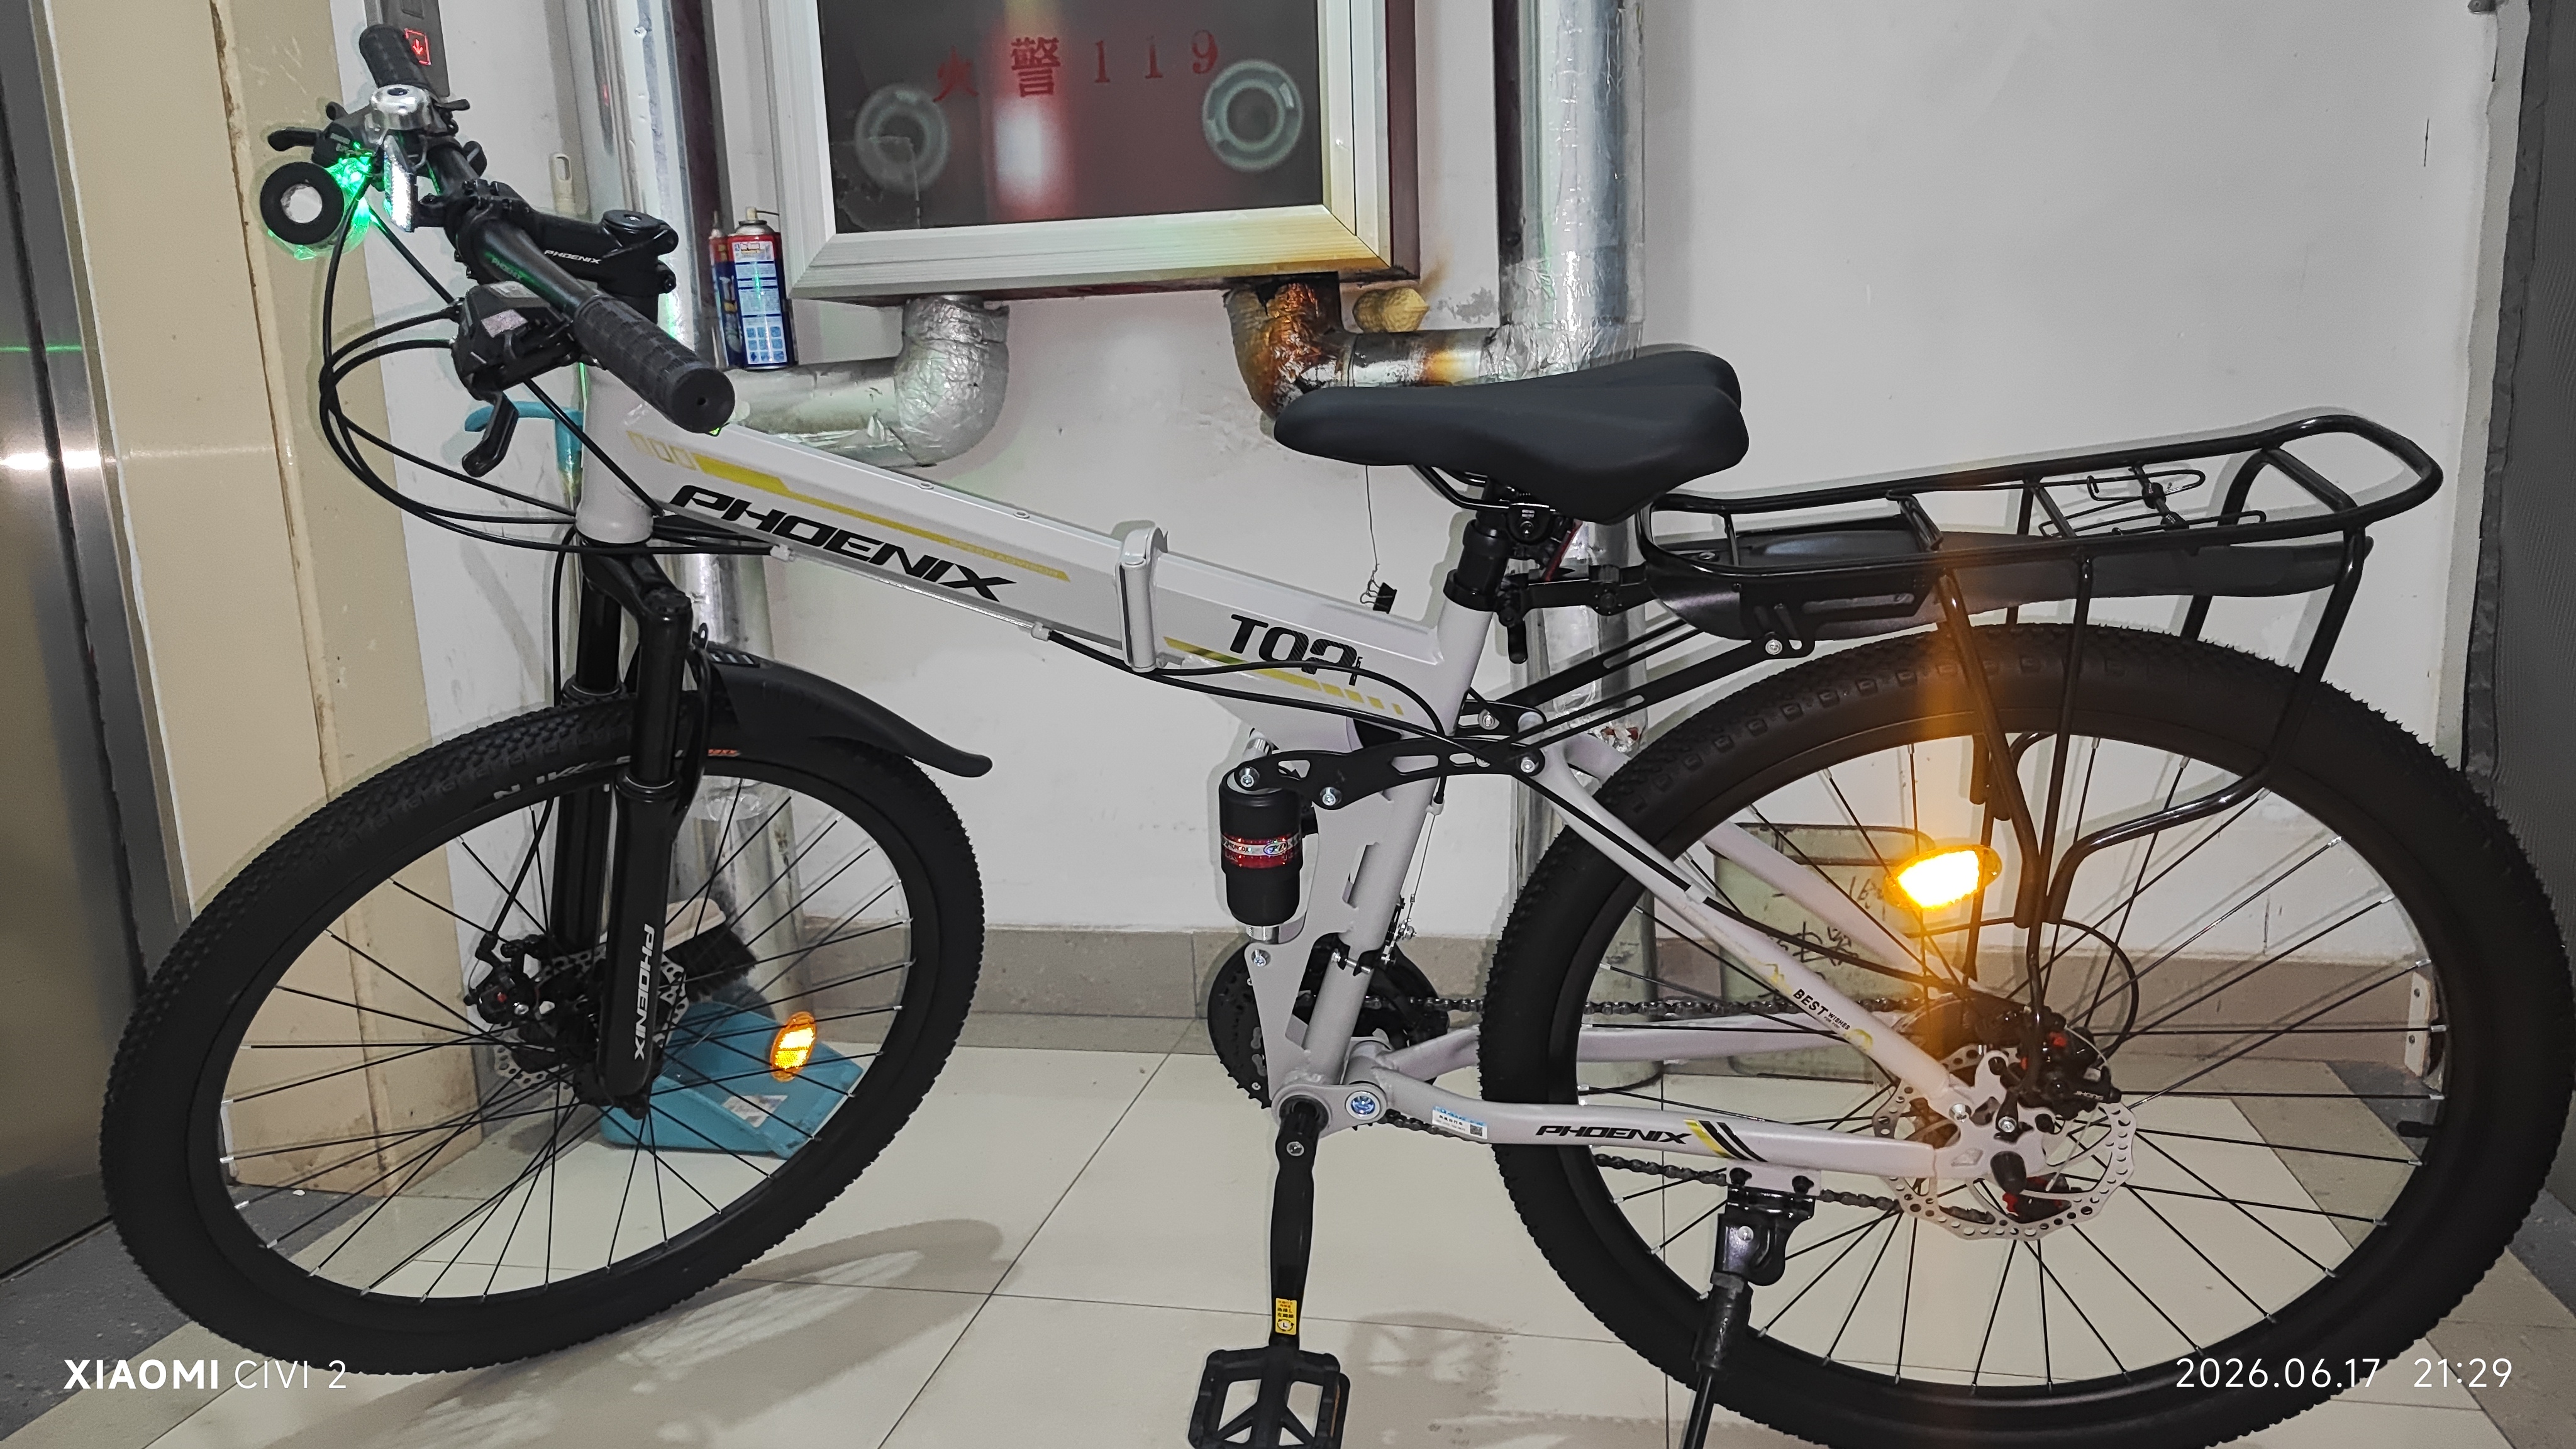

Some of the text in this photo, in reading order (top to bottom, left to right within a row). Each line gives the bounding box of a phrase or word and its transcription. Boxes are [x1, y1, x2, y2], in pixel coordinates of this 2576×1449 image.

[543, 249, 602, 264] PHOENIX
[670, 485, 1018, 602] PHOENIX
[634, 923, 655, 1061] PHOENIX
[1792, 988, 1851, 1030] BEST WISHES
[1535, 1124, 1692, 1144] PHOENIX
